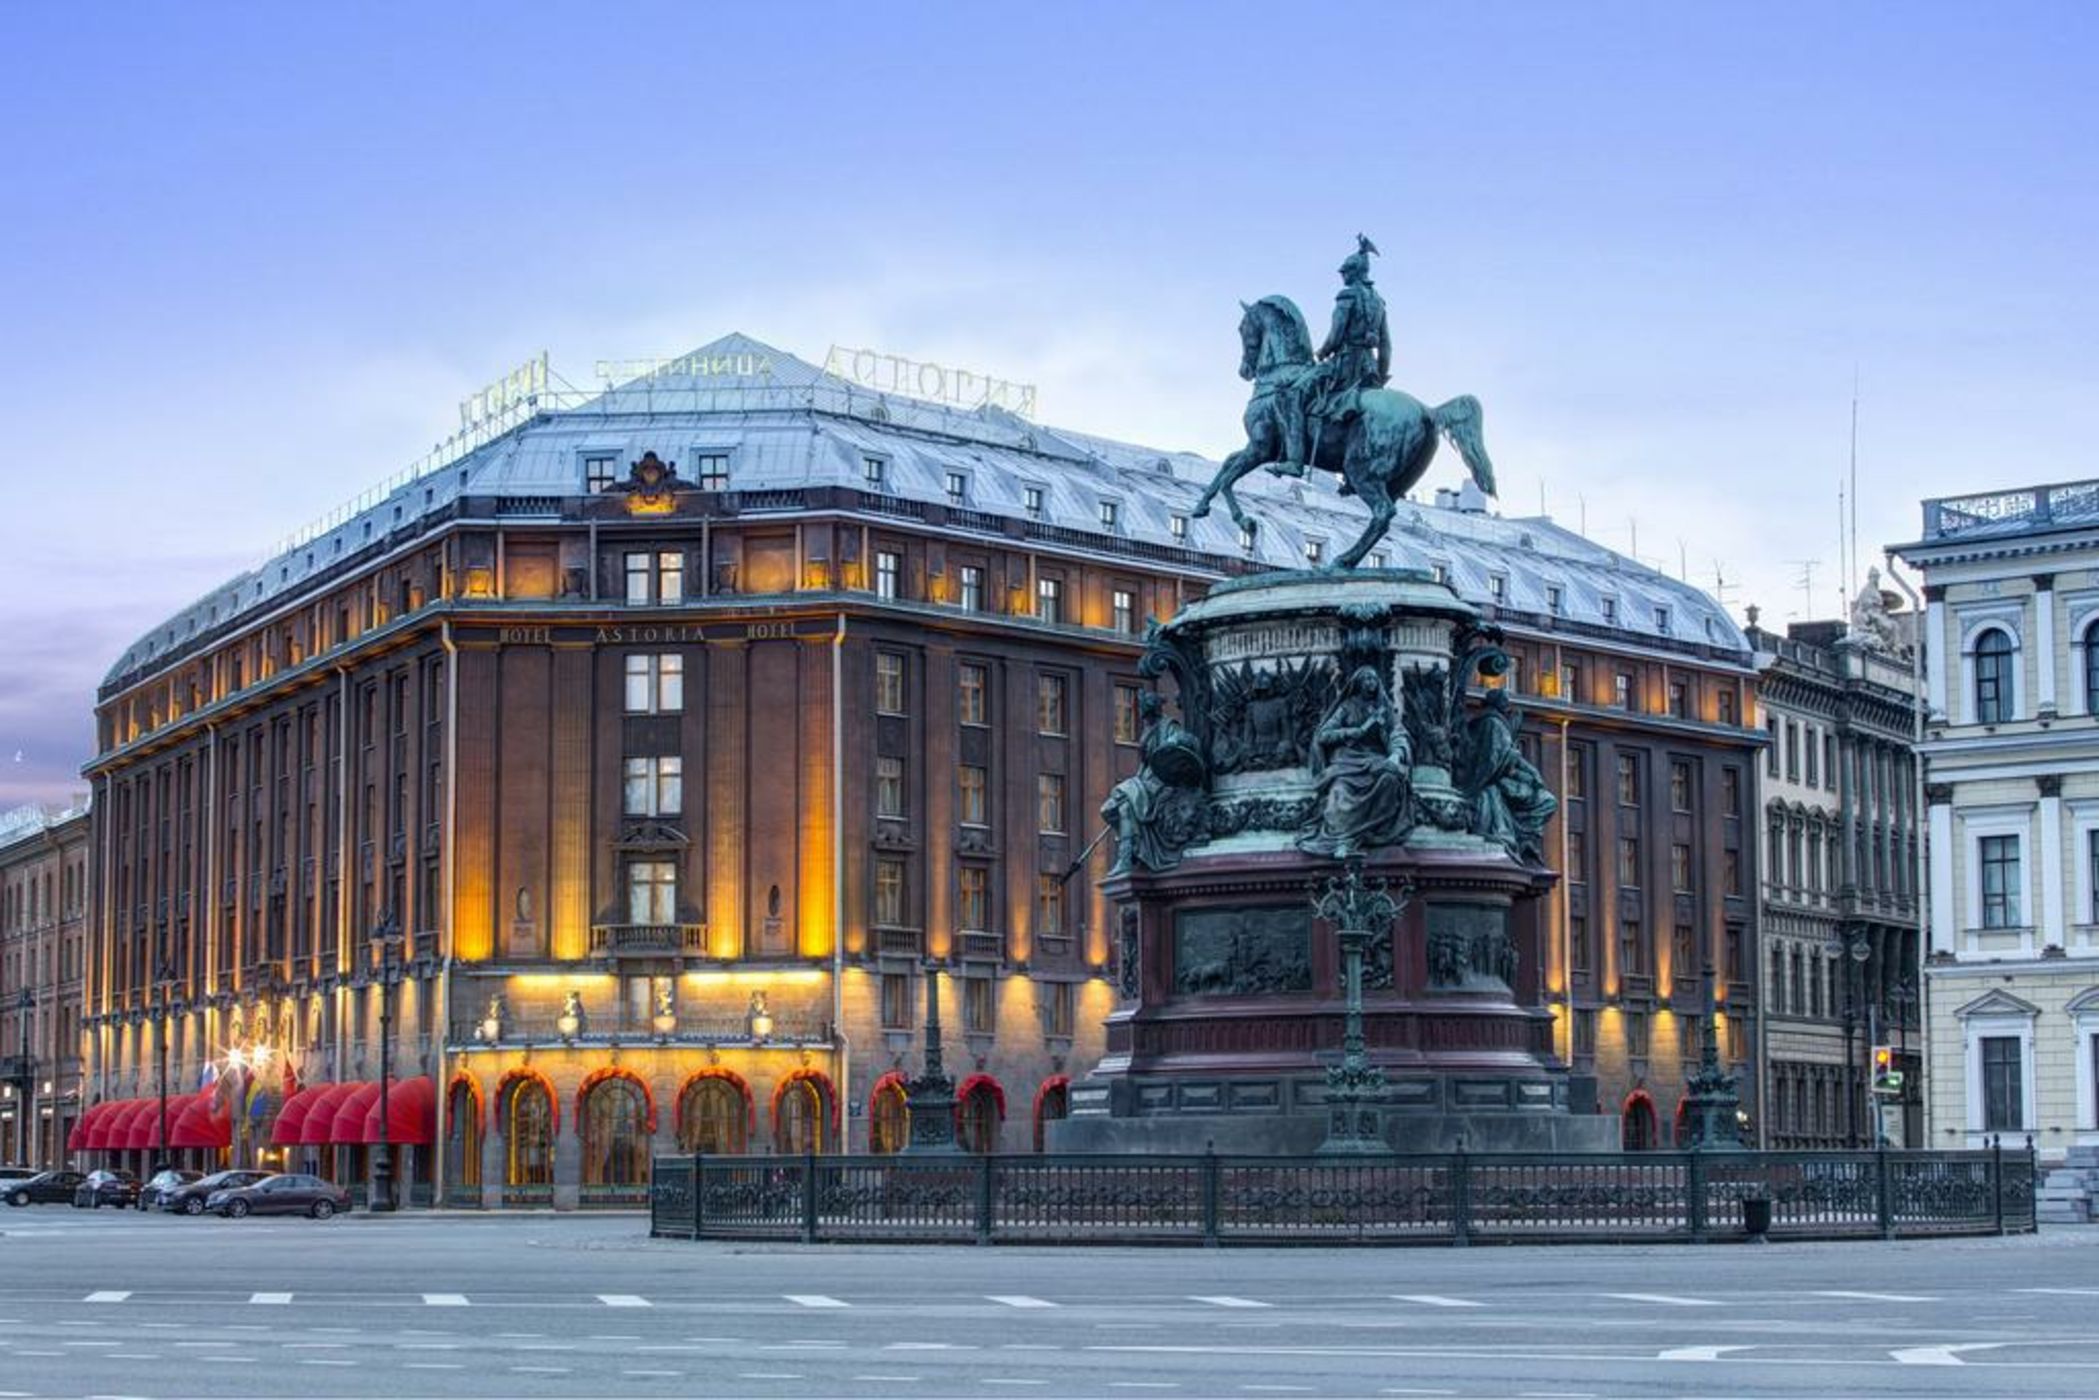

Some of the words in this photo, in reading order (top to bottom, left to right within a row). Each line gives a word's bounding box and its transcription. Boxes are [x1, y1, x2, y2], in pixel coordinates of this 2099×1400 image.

[500, 627, 551, 643] HOTEL
[596, 627, 705, 643] ASTORIA
[747, 623, 796, 640] HOTEL
